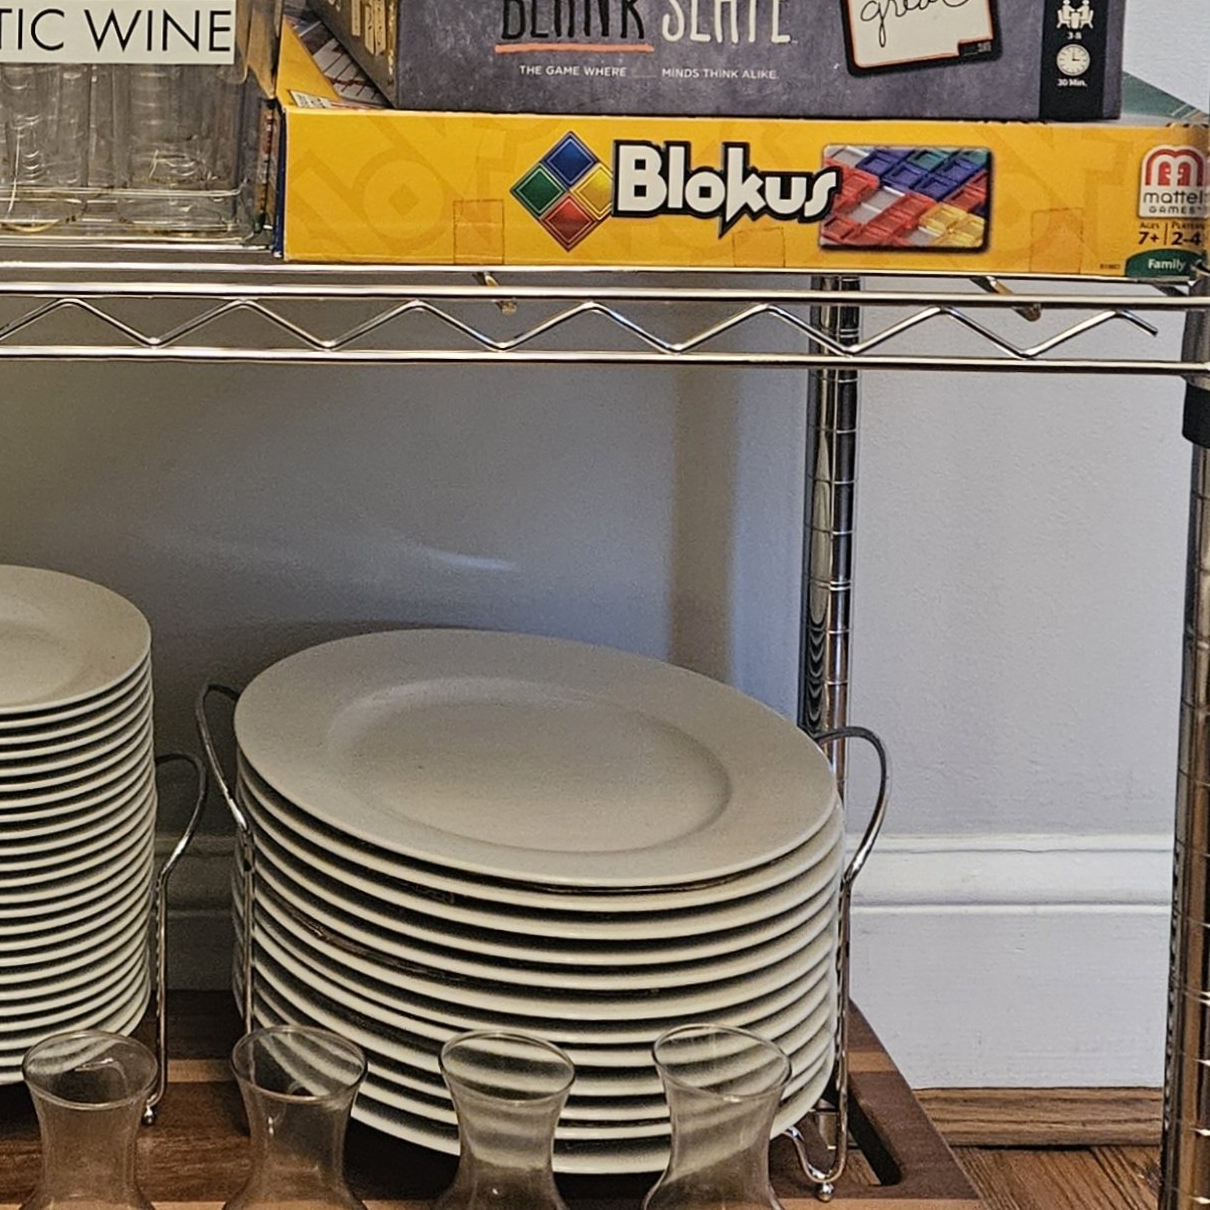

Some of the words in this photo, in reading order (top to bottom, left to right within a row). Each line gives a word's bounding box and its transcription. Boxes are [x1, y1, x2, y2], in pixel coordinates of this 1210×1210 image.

[84, 9, 233, 52] WINE
[519, 65, 542, 76] THE
[545, 65, 579, 77] GAME
[583, 66, 627, 78] WHERE
[662, 67, 699, 79] MINDS
[703, 68, 738, 79] THINK
[615, 142, 838, 236] Blokus
[1143, 190, 1203, 204] mattel
[1138, 231, 1160, 245] 7+
[1171, 231, 1202, 245] 2-4
[1148, 259, 1186, 271] Family
